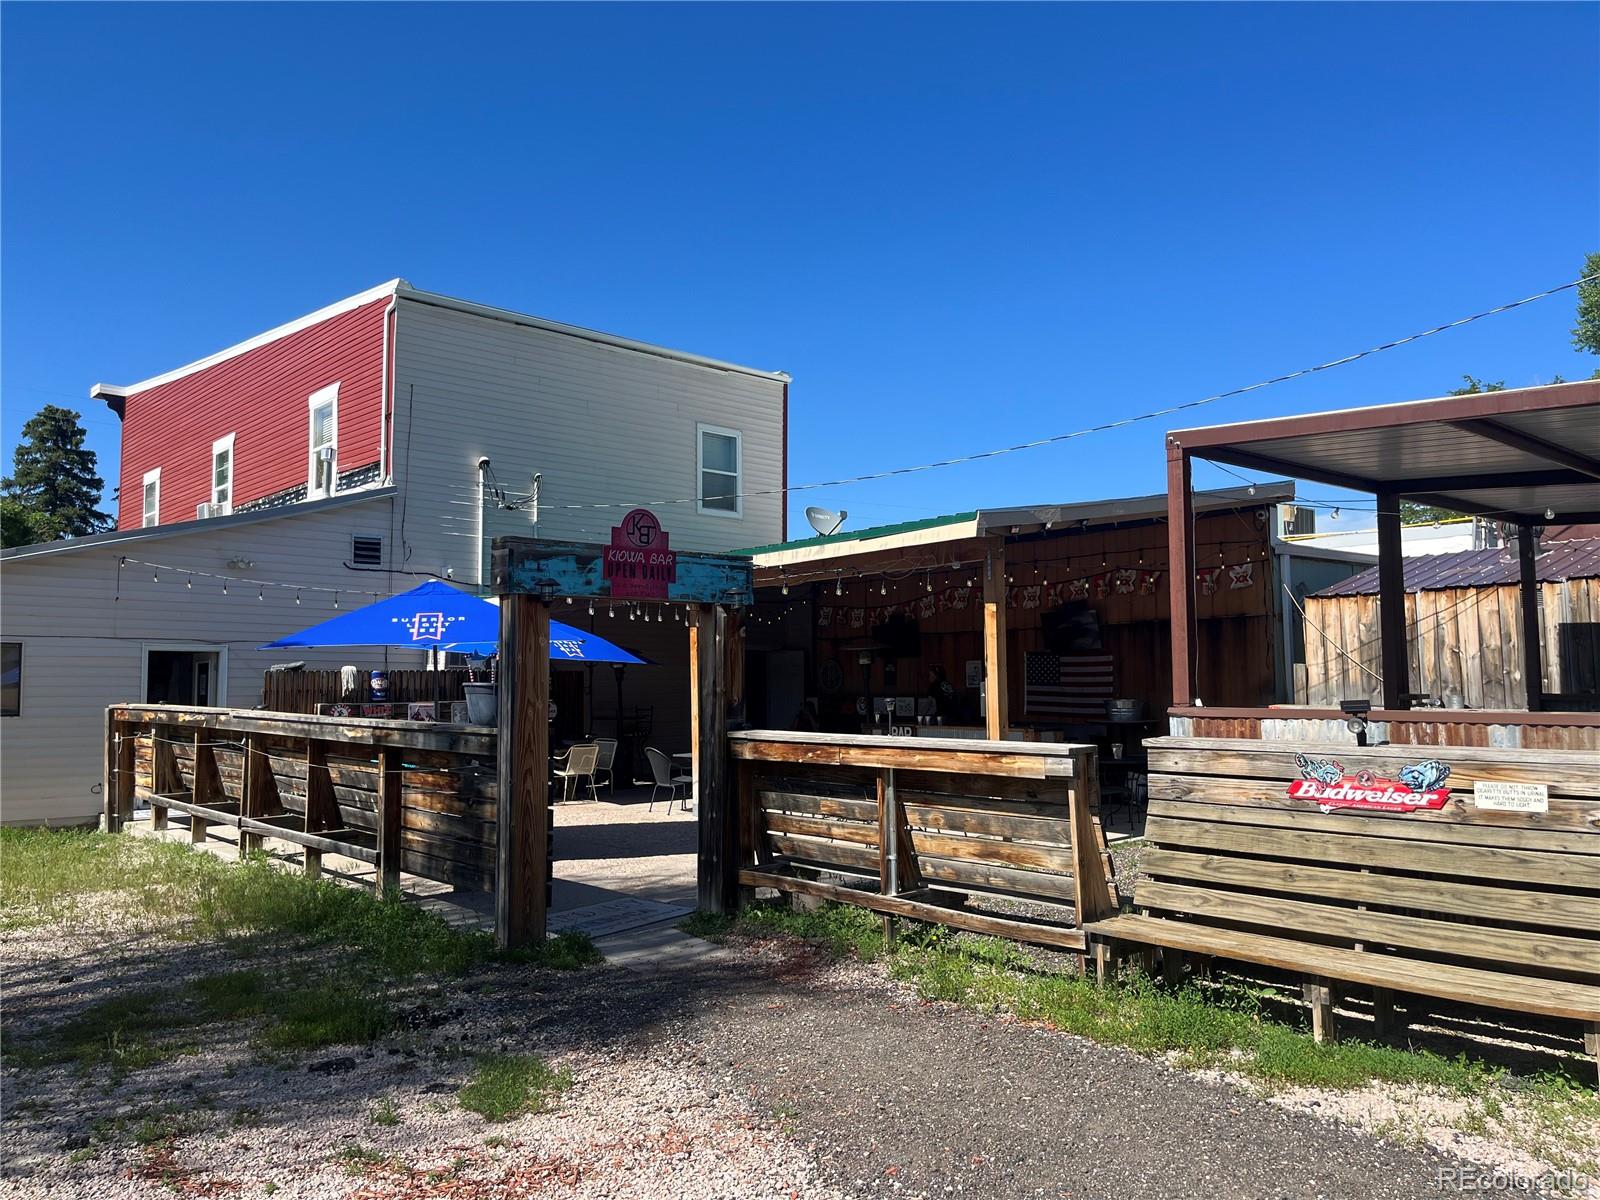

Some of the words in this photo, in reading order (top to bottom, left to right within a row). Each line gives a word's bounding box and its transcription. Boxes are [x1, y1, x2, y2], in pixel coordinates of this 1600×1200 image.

[608, 549, 645, 563] KIOWA
[650, 553, 673, 565] BAR
[608, 562, 637, 579] OPEN
[642, 564, 673, 582] DAILY
[1294, 780, 1439, 806] Budweiser
